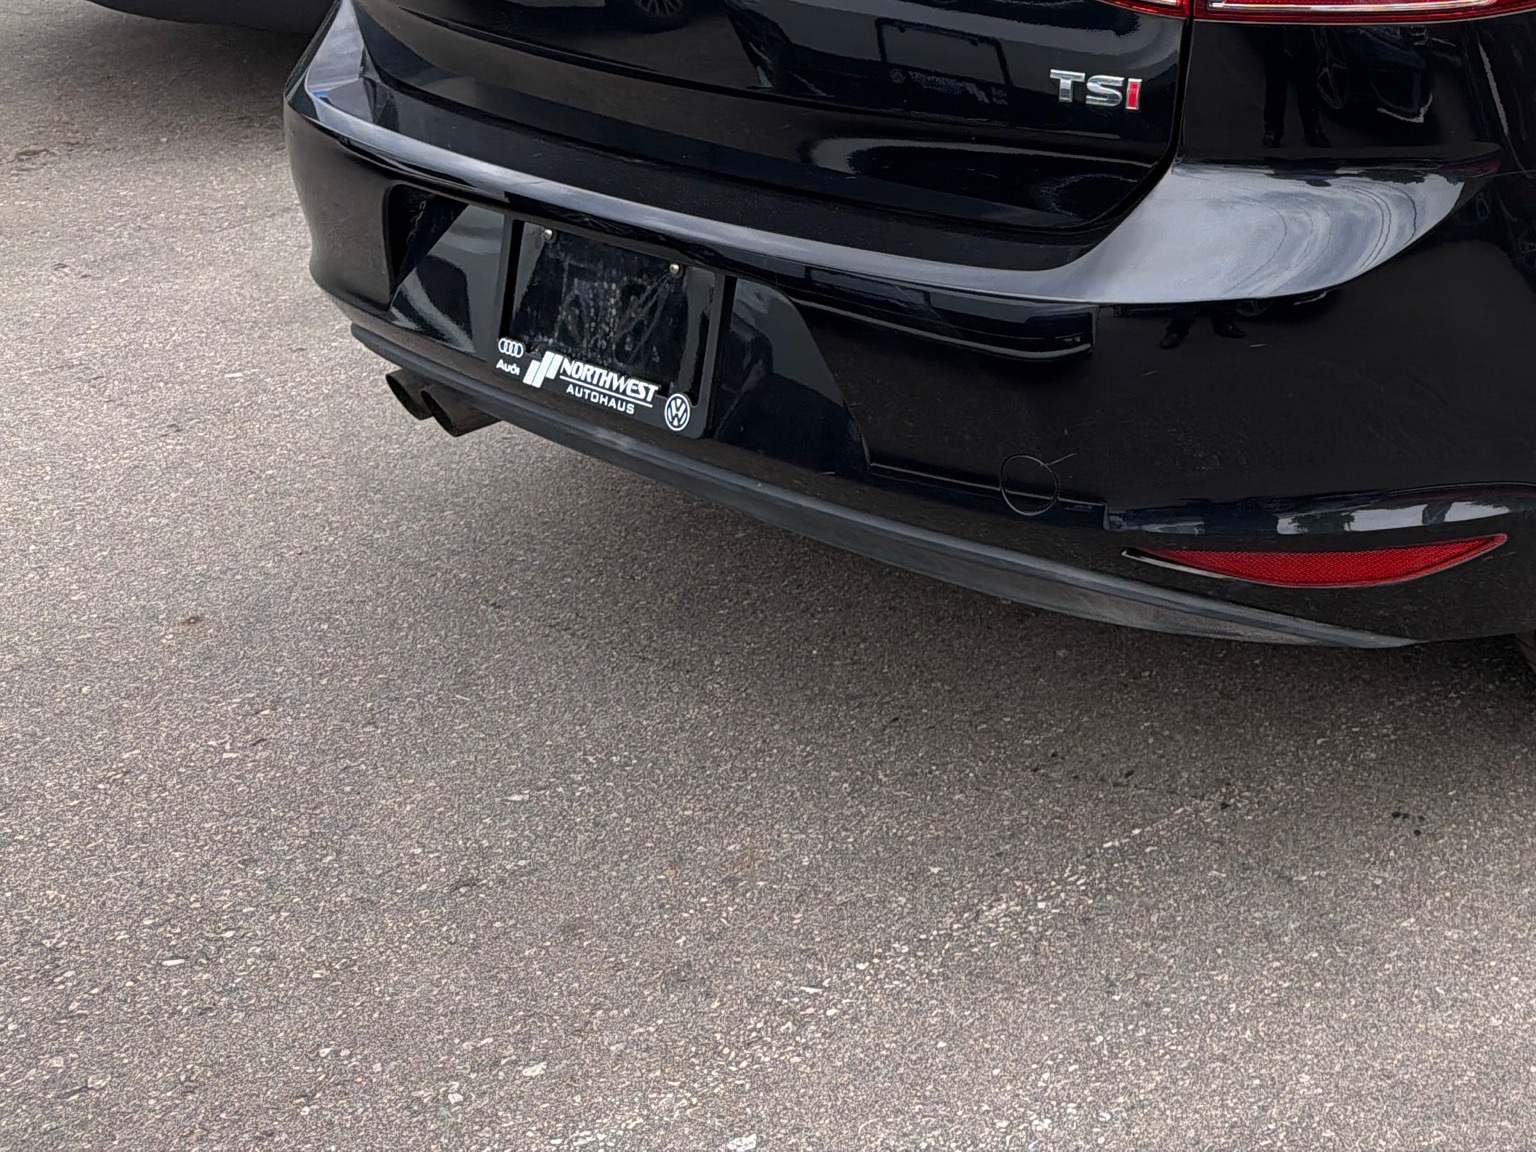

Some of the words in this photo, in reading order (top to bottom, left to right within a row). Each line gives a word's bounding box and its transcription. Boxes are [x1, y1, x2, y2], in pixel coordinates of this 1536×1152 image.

[1049, 69, 1142, 110] TSI
[496, 359, 520, 376] Audi
[560, 357, 659, 402] NORTHWEST
[566, 384, 635, 415] AUTOHAUS
